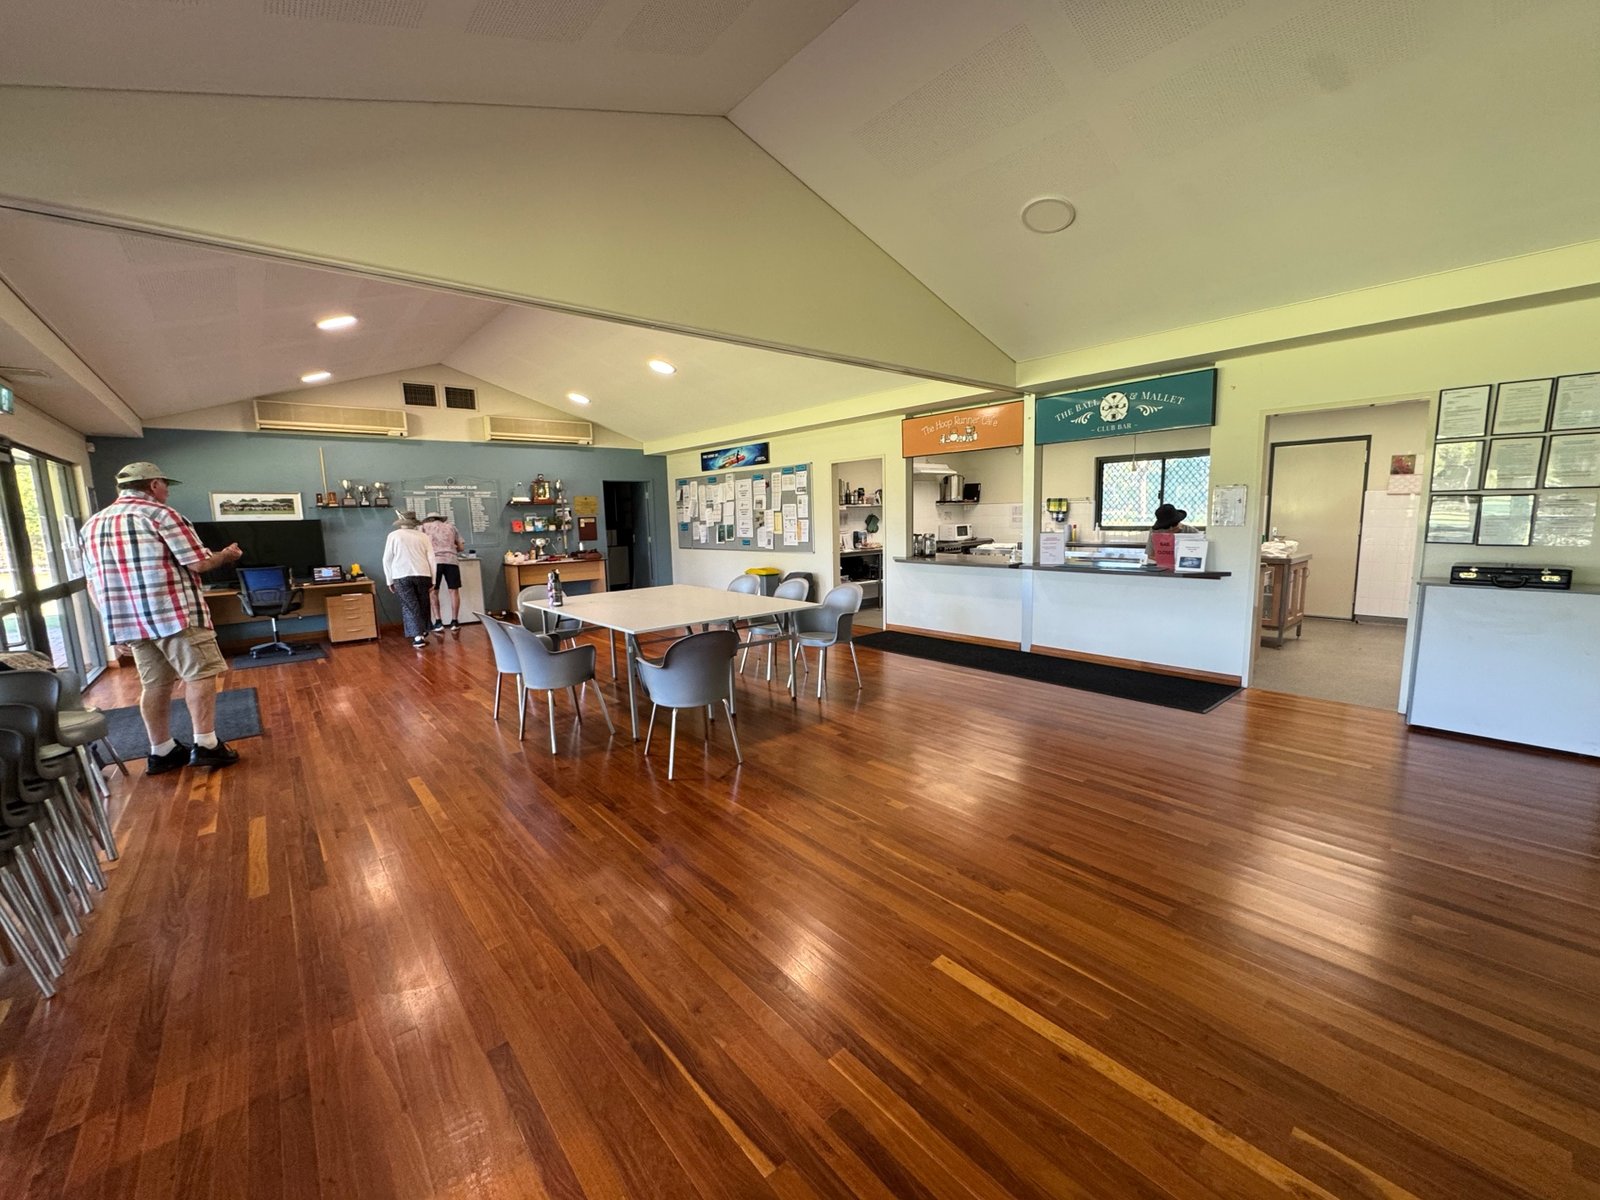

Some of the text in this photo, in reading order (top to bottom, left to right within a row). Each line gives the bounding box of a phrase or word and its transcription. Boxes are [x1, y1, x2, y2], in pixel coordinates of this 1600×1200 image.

[1054, 391, 1185, 422] THE BALL & MALLET
[921, 425, 935, 436] The
[935, 418, 953, 430] Hoop
[1096, 425, 1116, 433] CLUB
